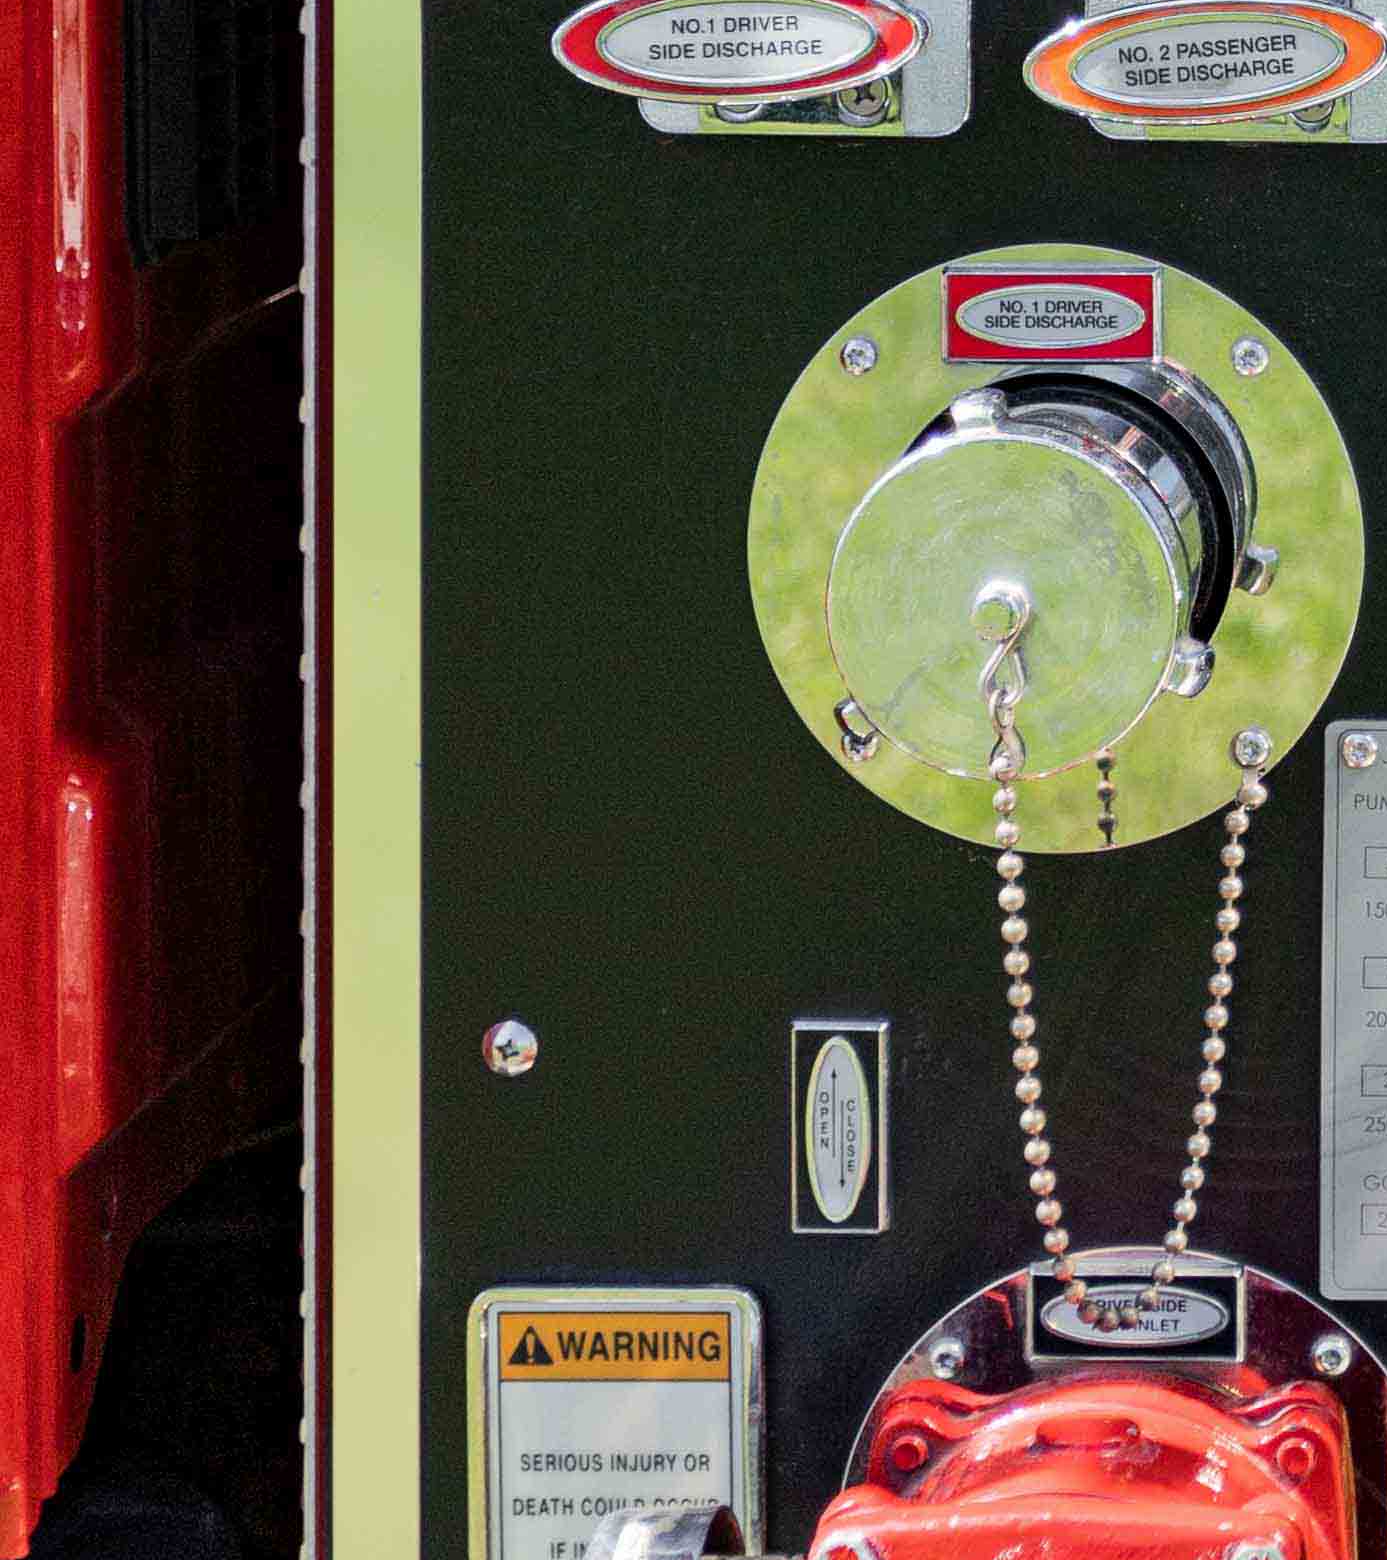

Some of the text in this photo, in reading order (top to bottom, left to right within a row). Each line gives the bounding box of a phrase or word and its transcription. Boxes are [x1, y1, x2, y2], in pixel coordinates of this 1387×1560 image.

[672, 16, 797, 34] NO.1 DRIVER
[646, 40, 821, 64] SIDE DISCHARGE
[1119, 35, 1296, 64] NO. 2 PASSENGER
[1126, 58, 1293, 86] SIDE DISCHARGE
[557, 1331, 722, 1362] WARNING
[521, 1454, 709, 1472] SERIOUS INJURY OR
